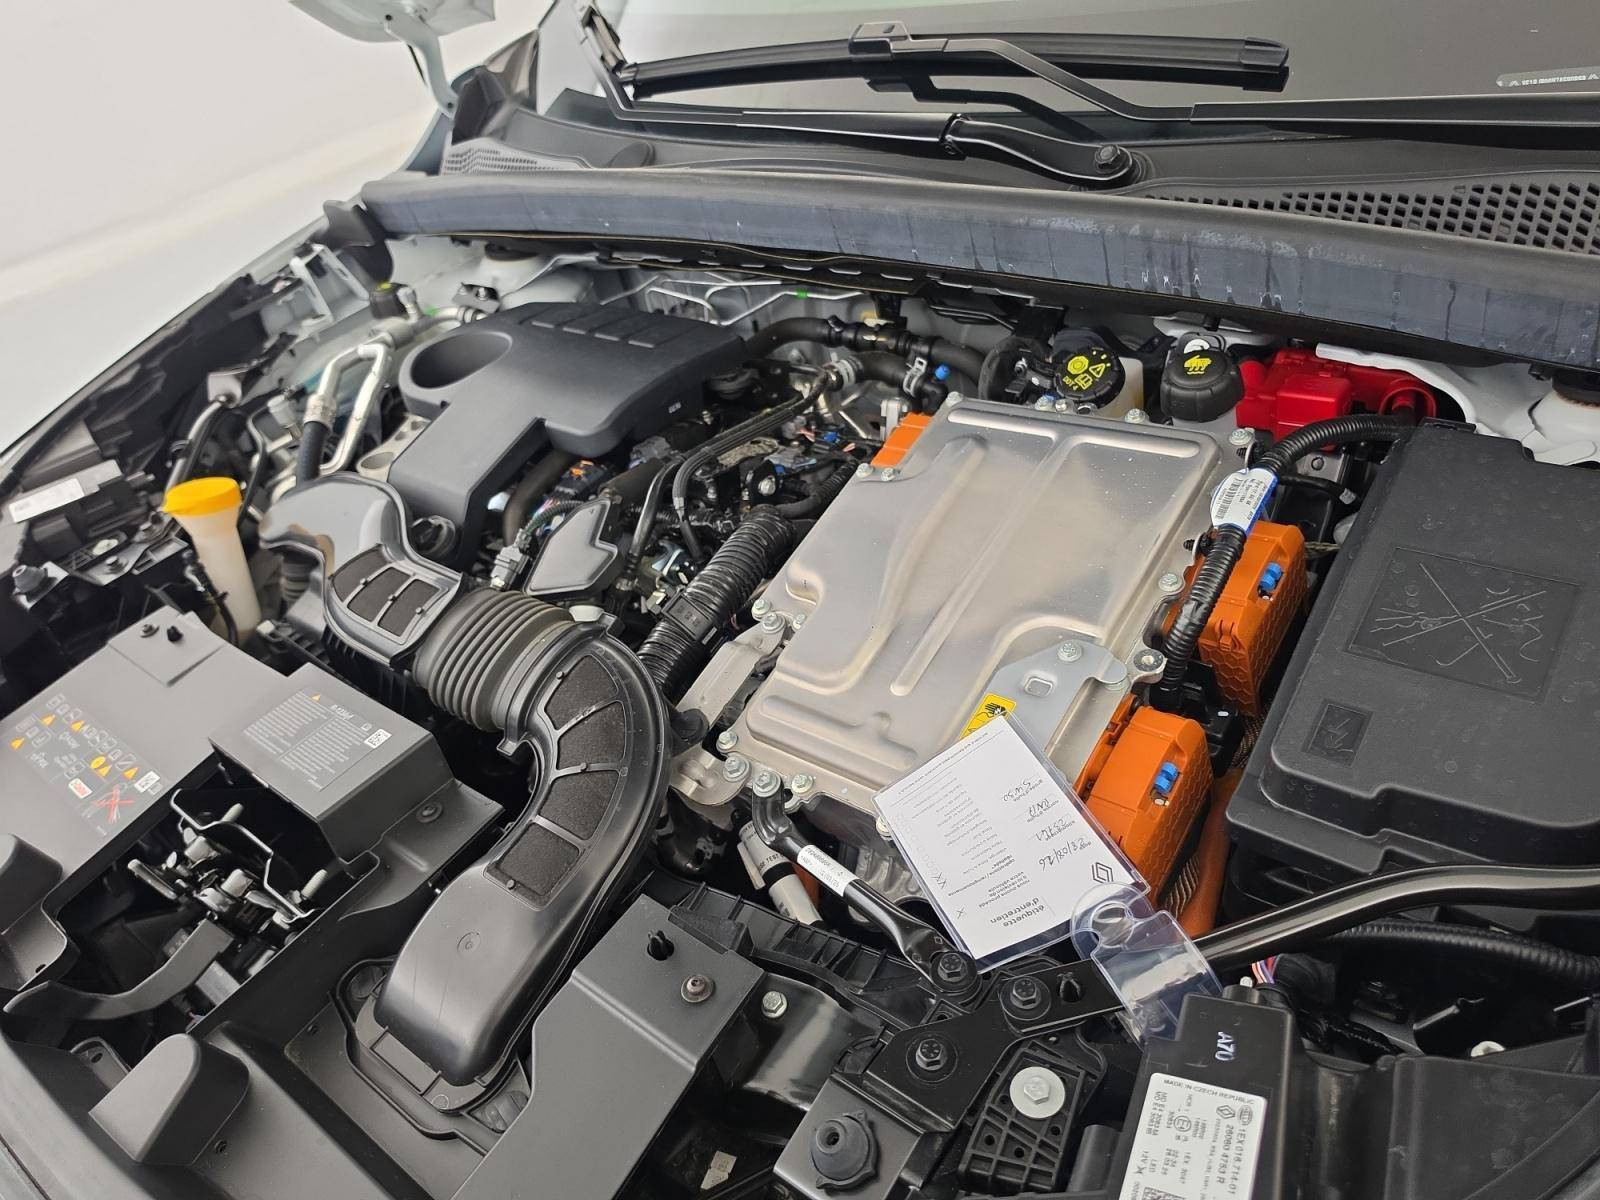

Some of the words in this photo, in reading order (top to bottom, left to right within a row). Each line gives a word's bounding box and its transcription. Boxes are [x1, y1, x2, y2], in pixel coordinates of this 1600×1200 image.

[1063, 375, 1075, 386] DOT
[990, 897, 1040, 924] d'entretien
[1003, 903, 1045, 927] étiquette
[1216, 1030, 1234, 1062] A70
[1164, 1079, 1185, 1088] MADE
[1193, 1087, 1218, 1096] CZECH
[1218, 1092, 1255, 1105] REPUBLIC
